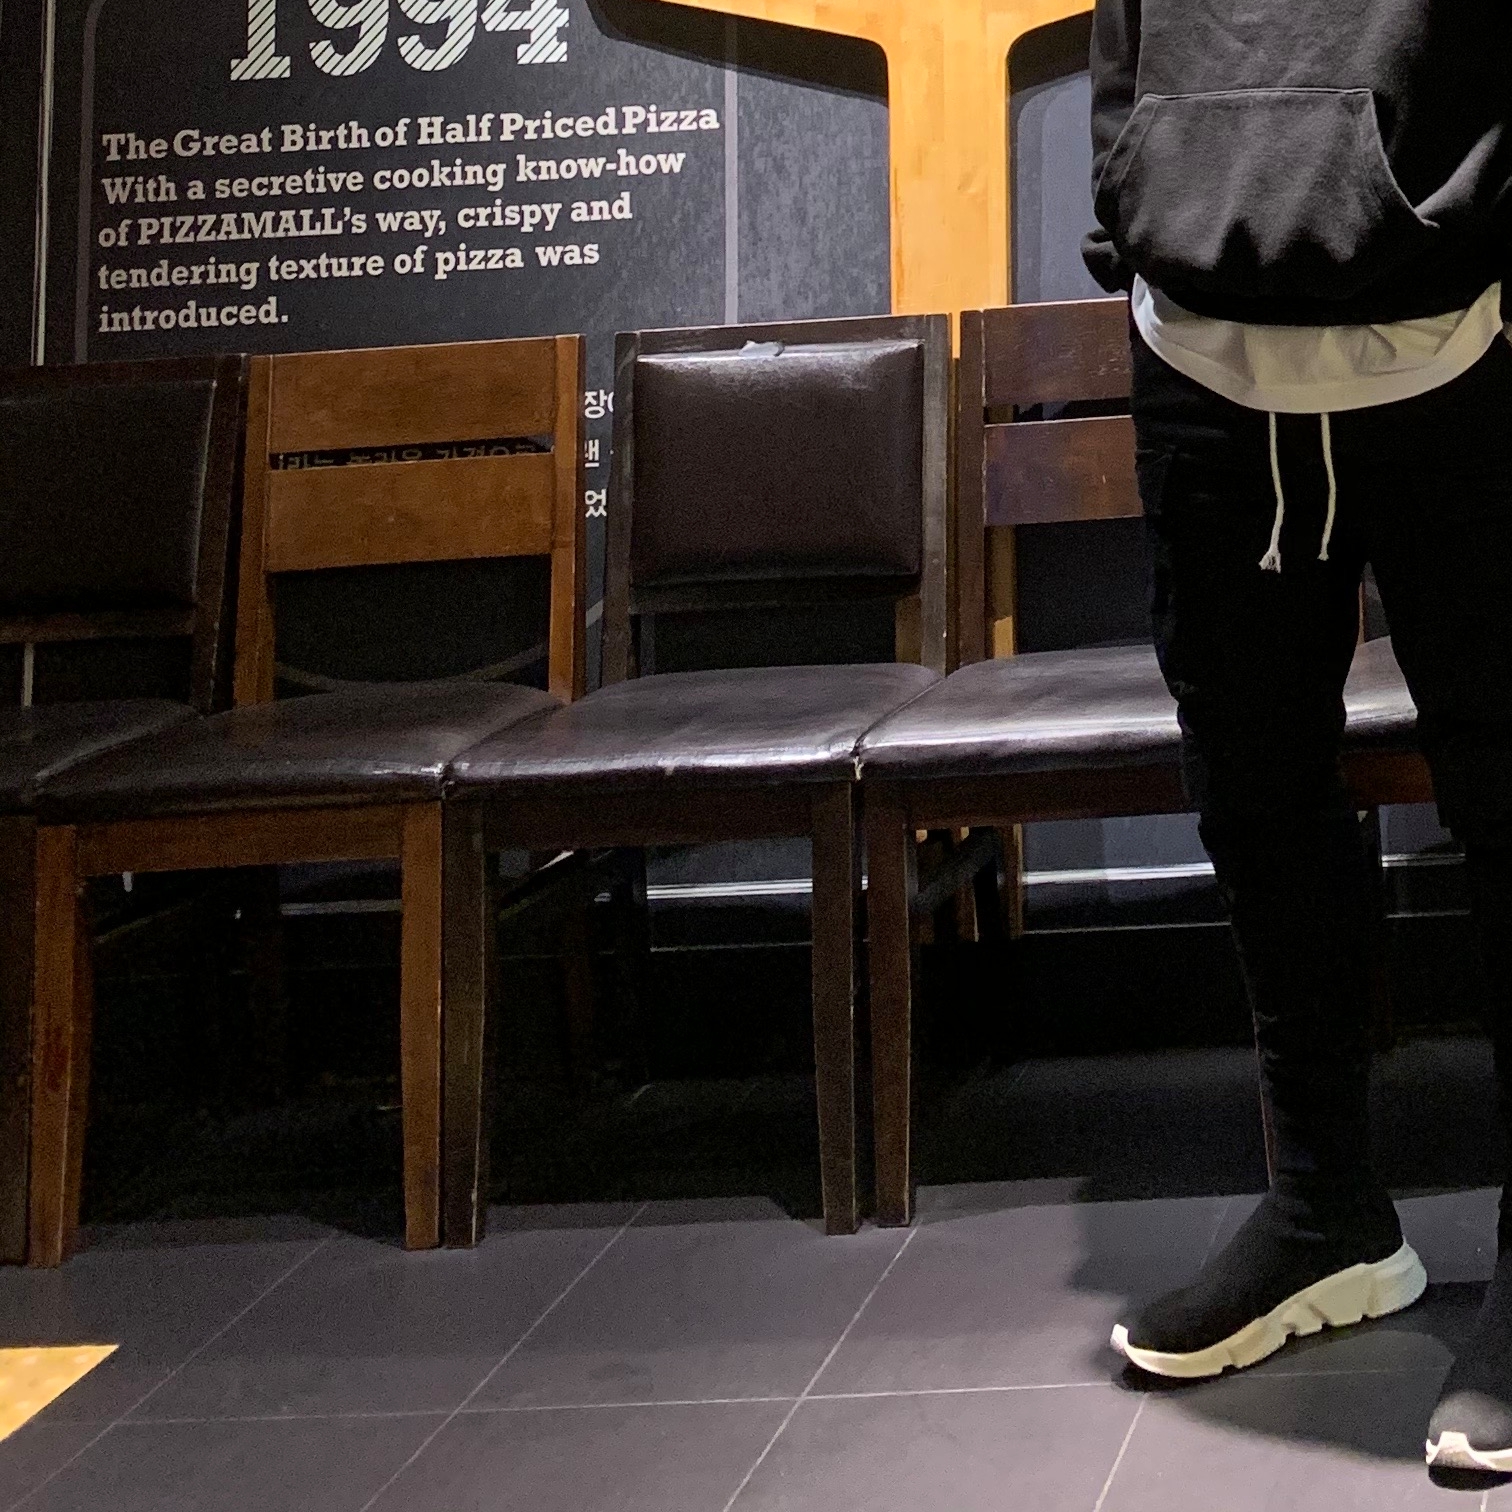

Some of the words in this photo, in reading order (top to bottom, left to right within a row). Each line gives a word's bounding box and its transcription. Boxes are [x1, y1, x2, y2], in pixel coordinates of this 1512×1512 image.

[102, 132, 169, 162] The
[172, 126, 273, 157] Great
[280, 120, 371, 153] Birth
[374, 117, 412, 147] of
[417, 112, 496, 145] Half
[499, 106, 619, 142] Priced
[621, 104, 720, 135] Pizza
[100, 174, 178, 205] With
[186, 179, 207, 201] a
[215, 165, 365, 199] secretive
[373, 157, 507, 192] cooking
[516, 147, 687, 182] know-how
[98, 218, 134, 248] of
[375, 209, 447, 238] way,
[457, 198, 563, 233] crispy
[570, 191, 633, 222] and
[97, 256, 261, 291] tendering
[267, 252, 385, 281] texture
[393, 244, 429, 274] of
[434, 242, 525, 280] pizza
[534, 243, 600, 267] was
[98, 295, 289, 333] introduced.
